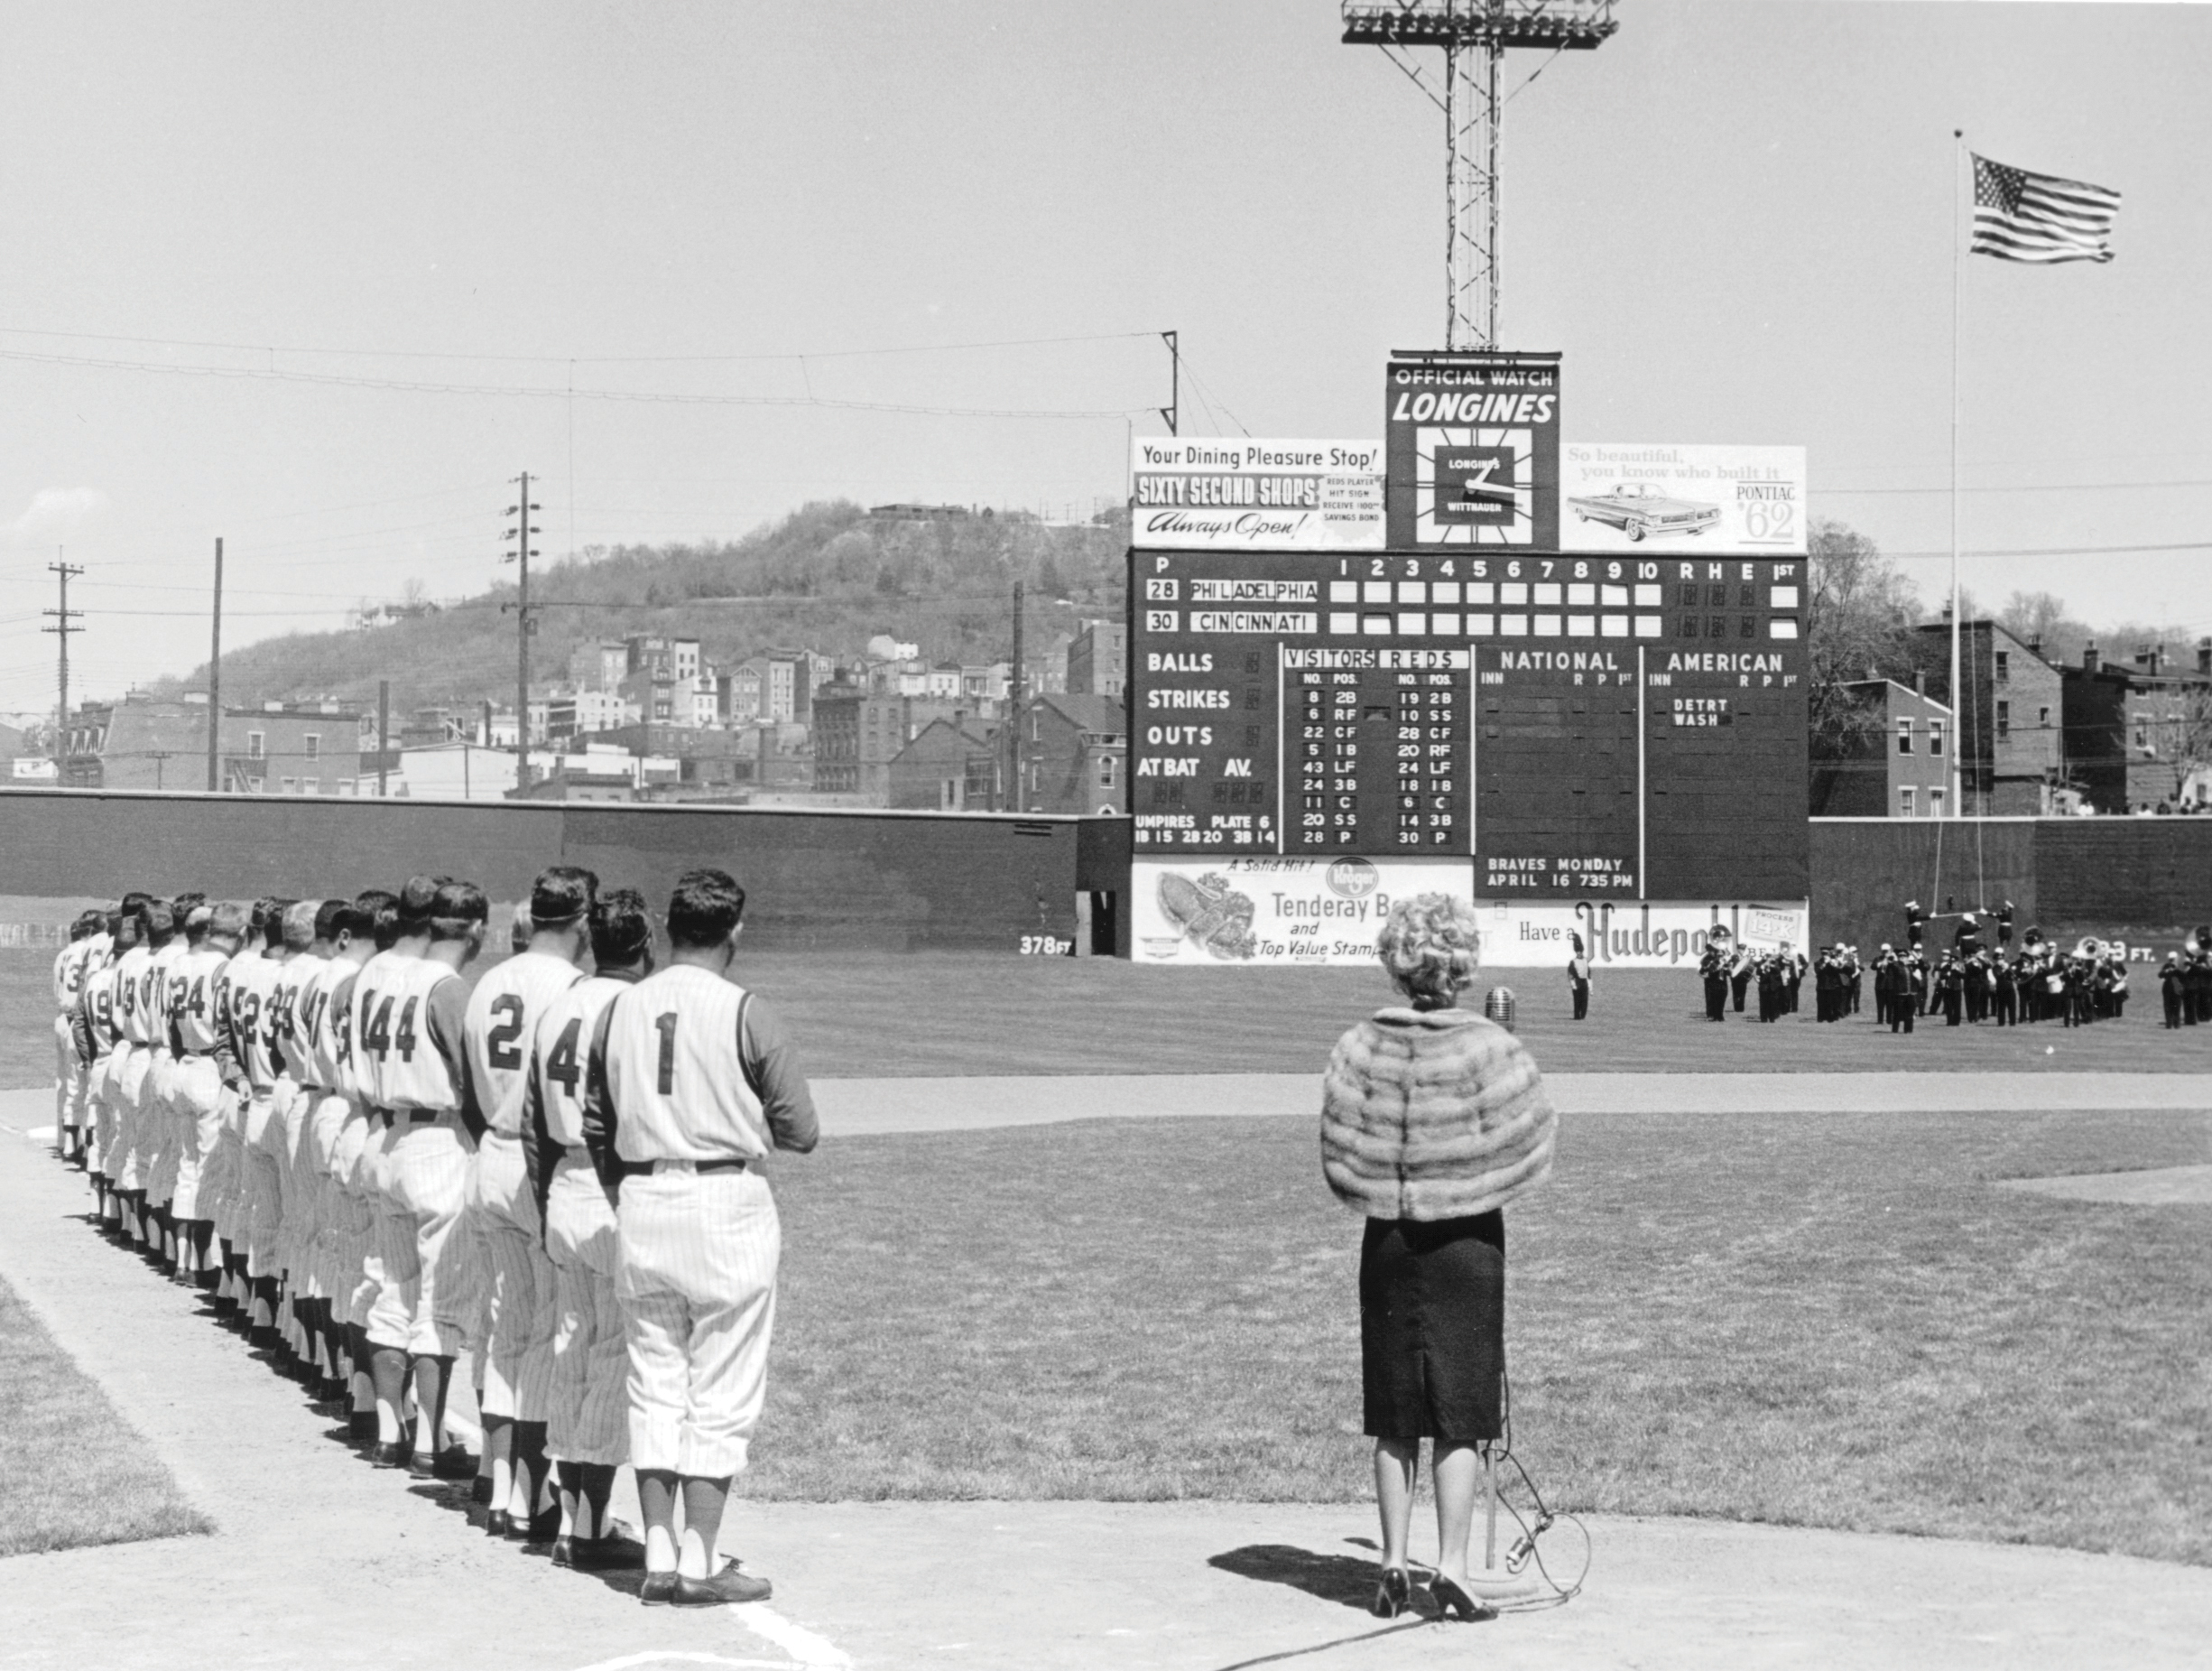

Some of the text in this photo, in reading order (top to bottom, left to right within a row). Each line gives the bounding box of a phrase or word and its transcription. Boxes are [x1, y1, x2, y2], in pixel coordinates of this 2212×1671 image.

[1394, 370, 1552, 388] OFFICIAL WATCH
[1393, 393, 1556, 422] LONGINES
[1143, 446, 1377, 471] Your Dining Pleasure Stop!
[1568, 447, 1592, 463] So
[1446, 457, 1502, 469] LONGINS
[1579, 463, 1616, 478] you
[1618, 463, 1671, 479] know
[1675, 464, 1713, 480] who
[1715, 464, 1761, 480] built
[1326, 477, 1376, 487] REDS PLAYER
[1137, 475, 1317, 508] SIXTY SECOND SHOPS
[1328, 489, 1346, 497] HIT
[1737, 487, 1794, 500] PONTIAC
[1322, 501, 1354, 510] RECEIVE
[1445, 501, 1504, 514] WITTNAUER
[1324, 513, 1380, 522] SAVINGS BOND
[1147, 512, 1309, 540] Always Open!
[1157, 557, 1169, 572] P
[1341, 559, 1658, 579] 1 2 3 4 5 6 7 8 9 10
[1680, 562, 1795, 580] R H E 1ST
[1152, 581, 1317, 599] 28 PHILADELPHIA
[1152, 613, 1309, 632] 30 CINCINNATI
[1148, 654, 1212, 672] BALLS
[1289, 650, 1374, 667] VISITORS
[1391, 651, 1453, 669] REDS
[1502, 652, 1617, 670] NATIONAL
[1668, 653, 1782, 672] AMERICAN
[1304, 673, 1357, 684] NO. POS.
[1399, 674, 1452, 685] NO. POS.
[1482, 673, 1503, 683] INN
[1574, 673, 1583, 685] R
[1598, 673, 1606, 684] P
[1650, 674, 1671, 685] INN
[1740, 675, 1748, 686] R
[1763, 675, 1772, 686] P
[1148, 690, 1229, 709] STRIKES
[1310, 692, 1356, 703] 8 2B
[1402, 692, 1451, 704] 19 2B
[1674, 699, 1727, 711] DETRT
[1310, 709, 1356, 720] 6 RF
[1402, 710, 1451, 721] 10 SS
[1674, 714, 1717, 726] WASH
[1148, 727, 1212, 745] OUTS
[1304, 727, 1356, 738] 22 CF
[1398, 727, 1450, 739] 28 CF
[1310, 744, 1356, 756] 5 1B
[1398, 745, 1450, 757] 20 RF
[1225, 759, 1251, 776] AV.
[1303, 761, 1356, 773] 43 LF
[1399, 762, 1450, 774] 24 LF
[1304, 779, 1356, 791] 24 3B
[1402, 780, 1451, 792] 18 1B
[1306, 797, 1350, 809] 11 C
[1404, 797, 1445, 809] 6 C
[1135, 815, 1270, 829] UMPIRES PLATE 6
[1303, 813, 1356, 826] 20 SS
[1402, 814, 1451, 826] 14 3B
[1135, 831, 1275, 843] 1B 15 2B 20 3B 14
[1304, 831, 1350, 843] 28 P
[1400, 832, 1446, 843] 30 P
[1226, 859, 1316, 873] A Solid Hit!
[1488, 859, 1622, 871] BRAVES MONDAY
[1333, 864, 1376, 894] Kroger
[1488, 874, 1632, 887] APRIL 16 735 PM
[1273, 892, 1368, 923] Tenderay
[1755, 911, 1794, 923] PROCESS
[1291, 922, 1319, 934] and
[1520, 922, 1560, 940] Have
[1566, 927, 1576, 941] a
[1261, 940, 1284, 958] Top
[1290, 941, 1328, 955] Value
[2131, 948, 2156, 961] FT.
[488, 994, 524, 1071] 2
[546, 1018, 582, 1098] 4
[655, 1011, 678, 1097] 1
